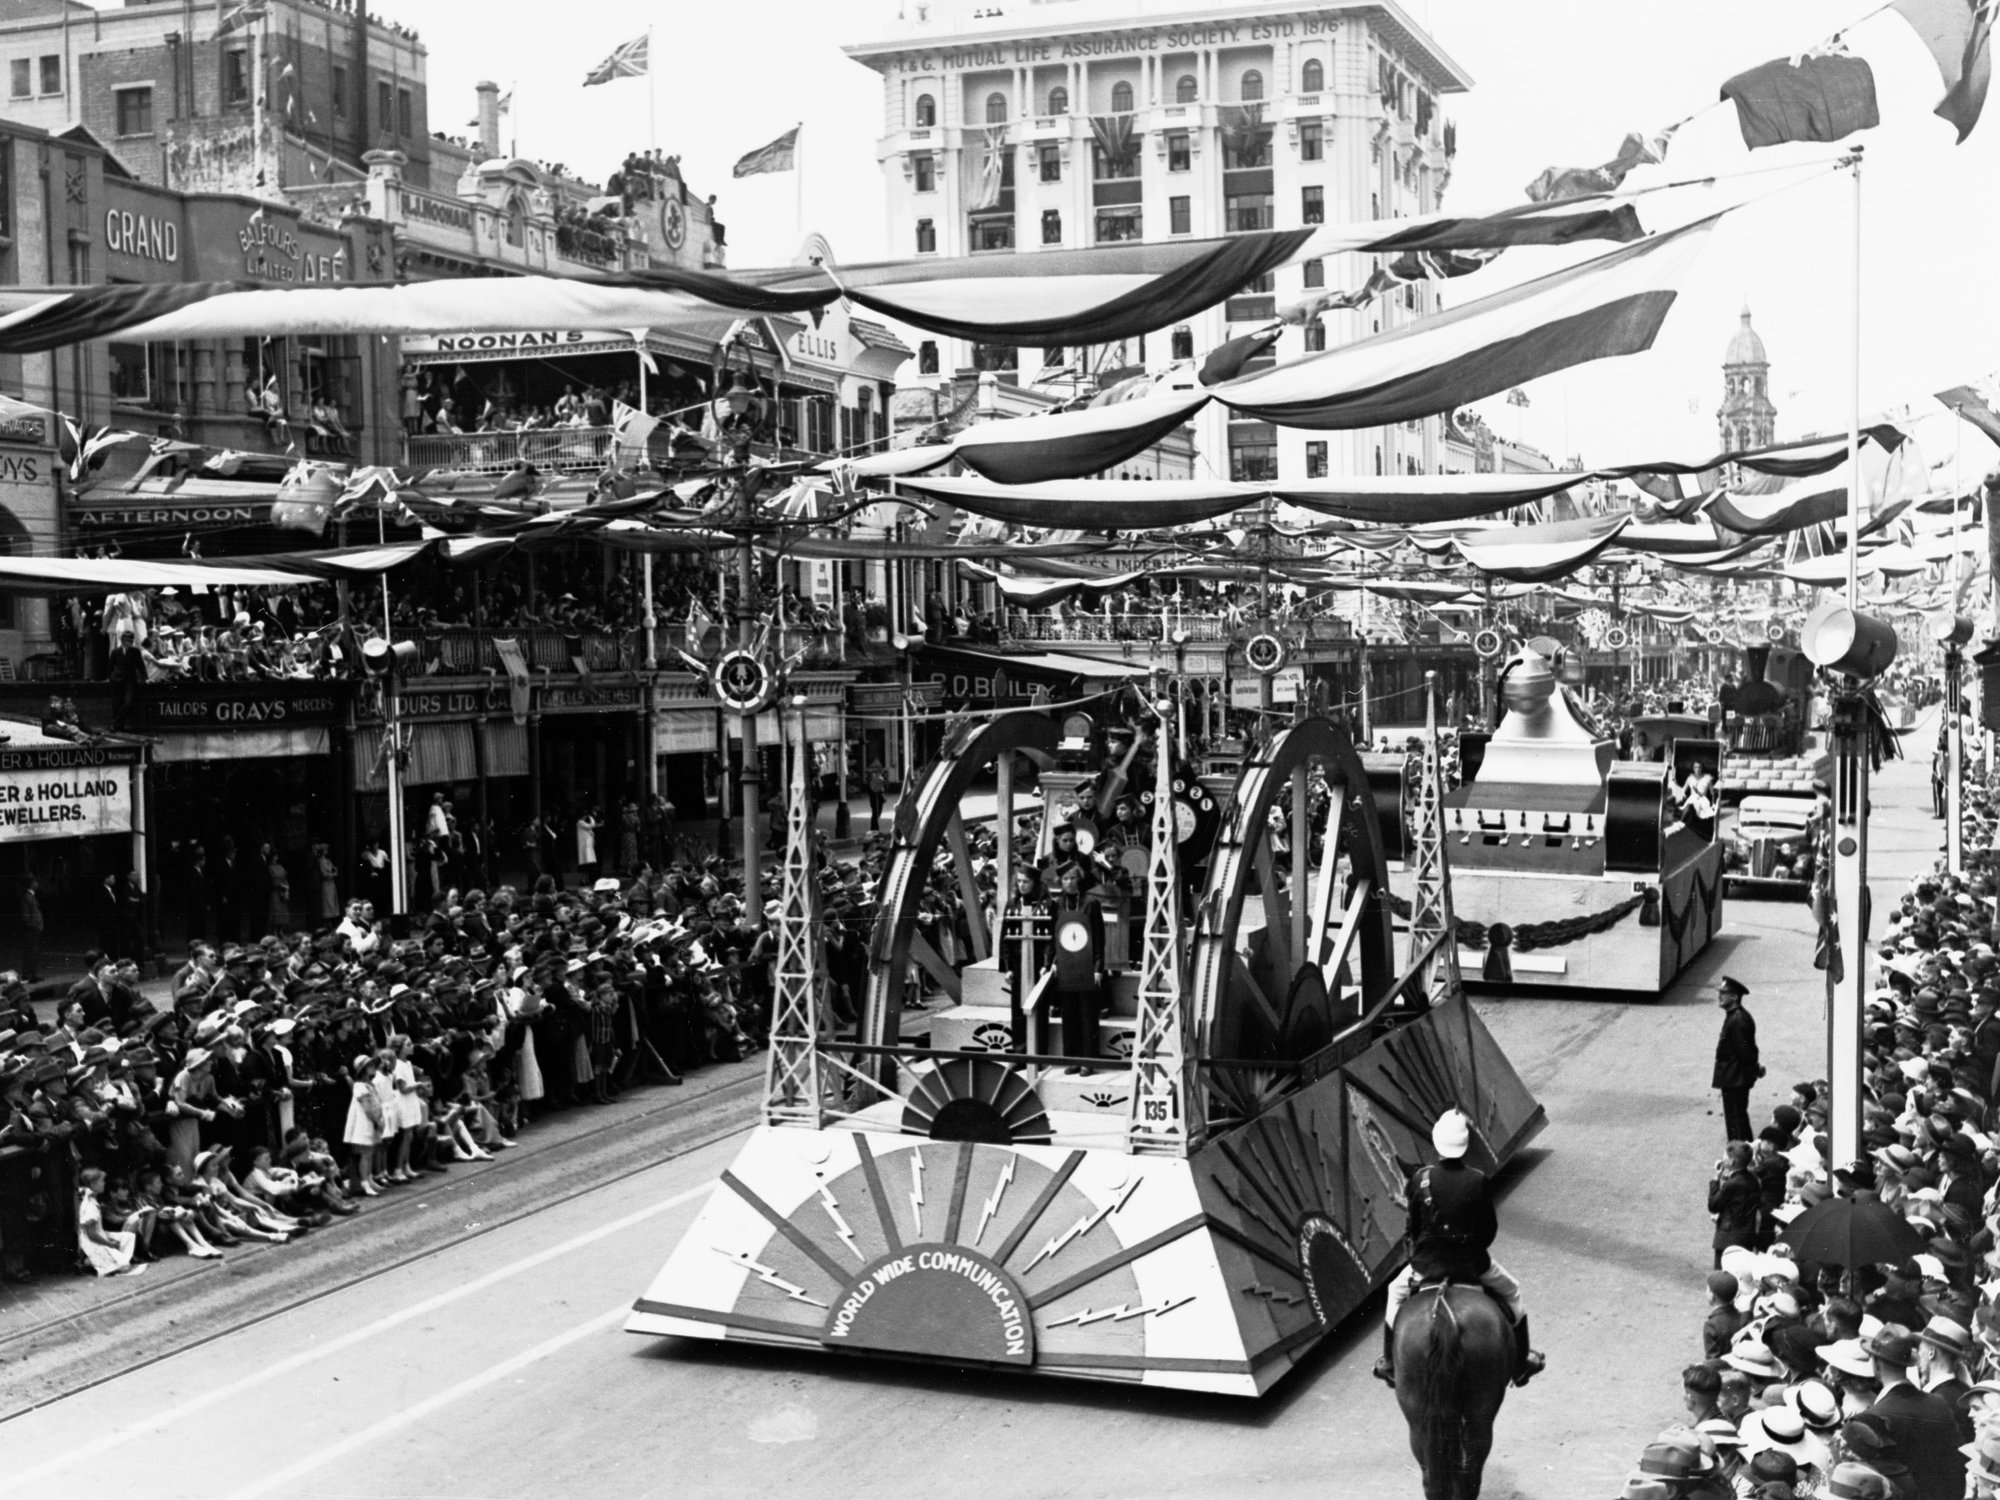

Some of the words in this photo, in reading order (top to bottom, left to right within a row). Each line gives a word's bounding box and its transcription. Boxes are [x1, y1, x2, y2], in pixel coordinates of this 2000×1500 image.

[942, 50, 1006, 70] MUTUAL
[1014, 44, 1051, 63] LIFE
[1061, 32, 1159, 58] ASSURANCE
[105, 208, 177, 262] GRAND
[246, 257, 295, 281] LIMITED
[797, 333, 837, 361] ELLIS
[79, 507, 251, 525] AFTERNOON
[357, 693, 441, 717] BAOURS
[447, 693, 479, 713] LTD.
[590, 688, 636, 705] CHEMIST
[159, 702, 208, 717] TAILORS
[215, 700, 286, 721] GRAYS
[25, 753, 34, 769] &
[38, 749, 105, 768] HOLLAND
[24, 786, 34, 802] &
[38, 779, 118, 801] HOLLAND
[1143, 792, 1152, 803] 5
[1175, 781, 1184, 791] 3
[1193, 787, 1200, 798] 2
[1144, 1100, 1168, 1121] 135
[830, 1280, 876, 1337] WORLD
[872, 1255, 917, 1286] WIDE
[918, 1251, 1025, 1356] COMMUNICATION
